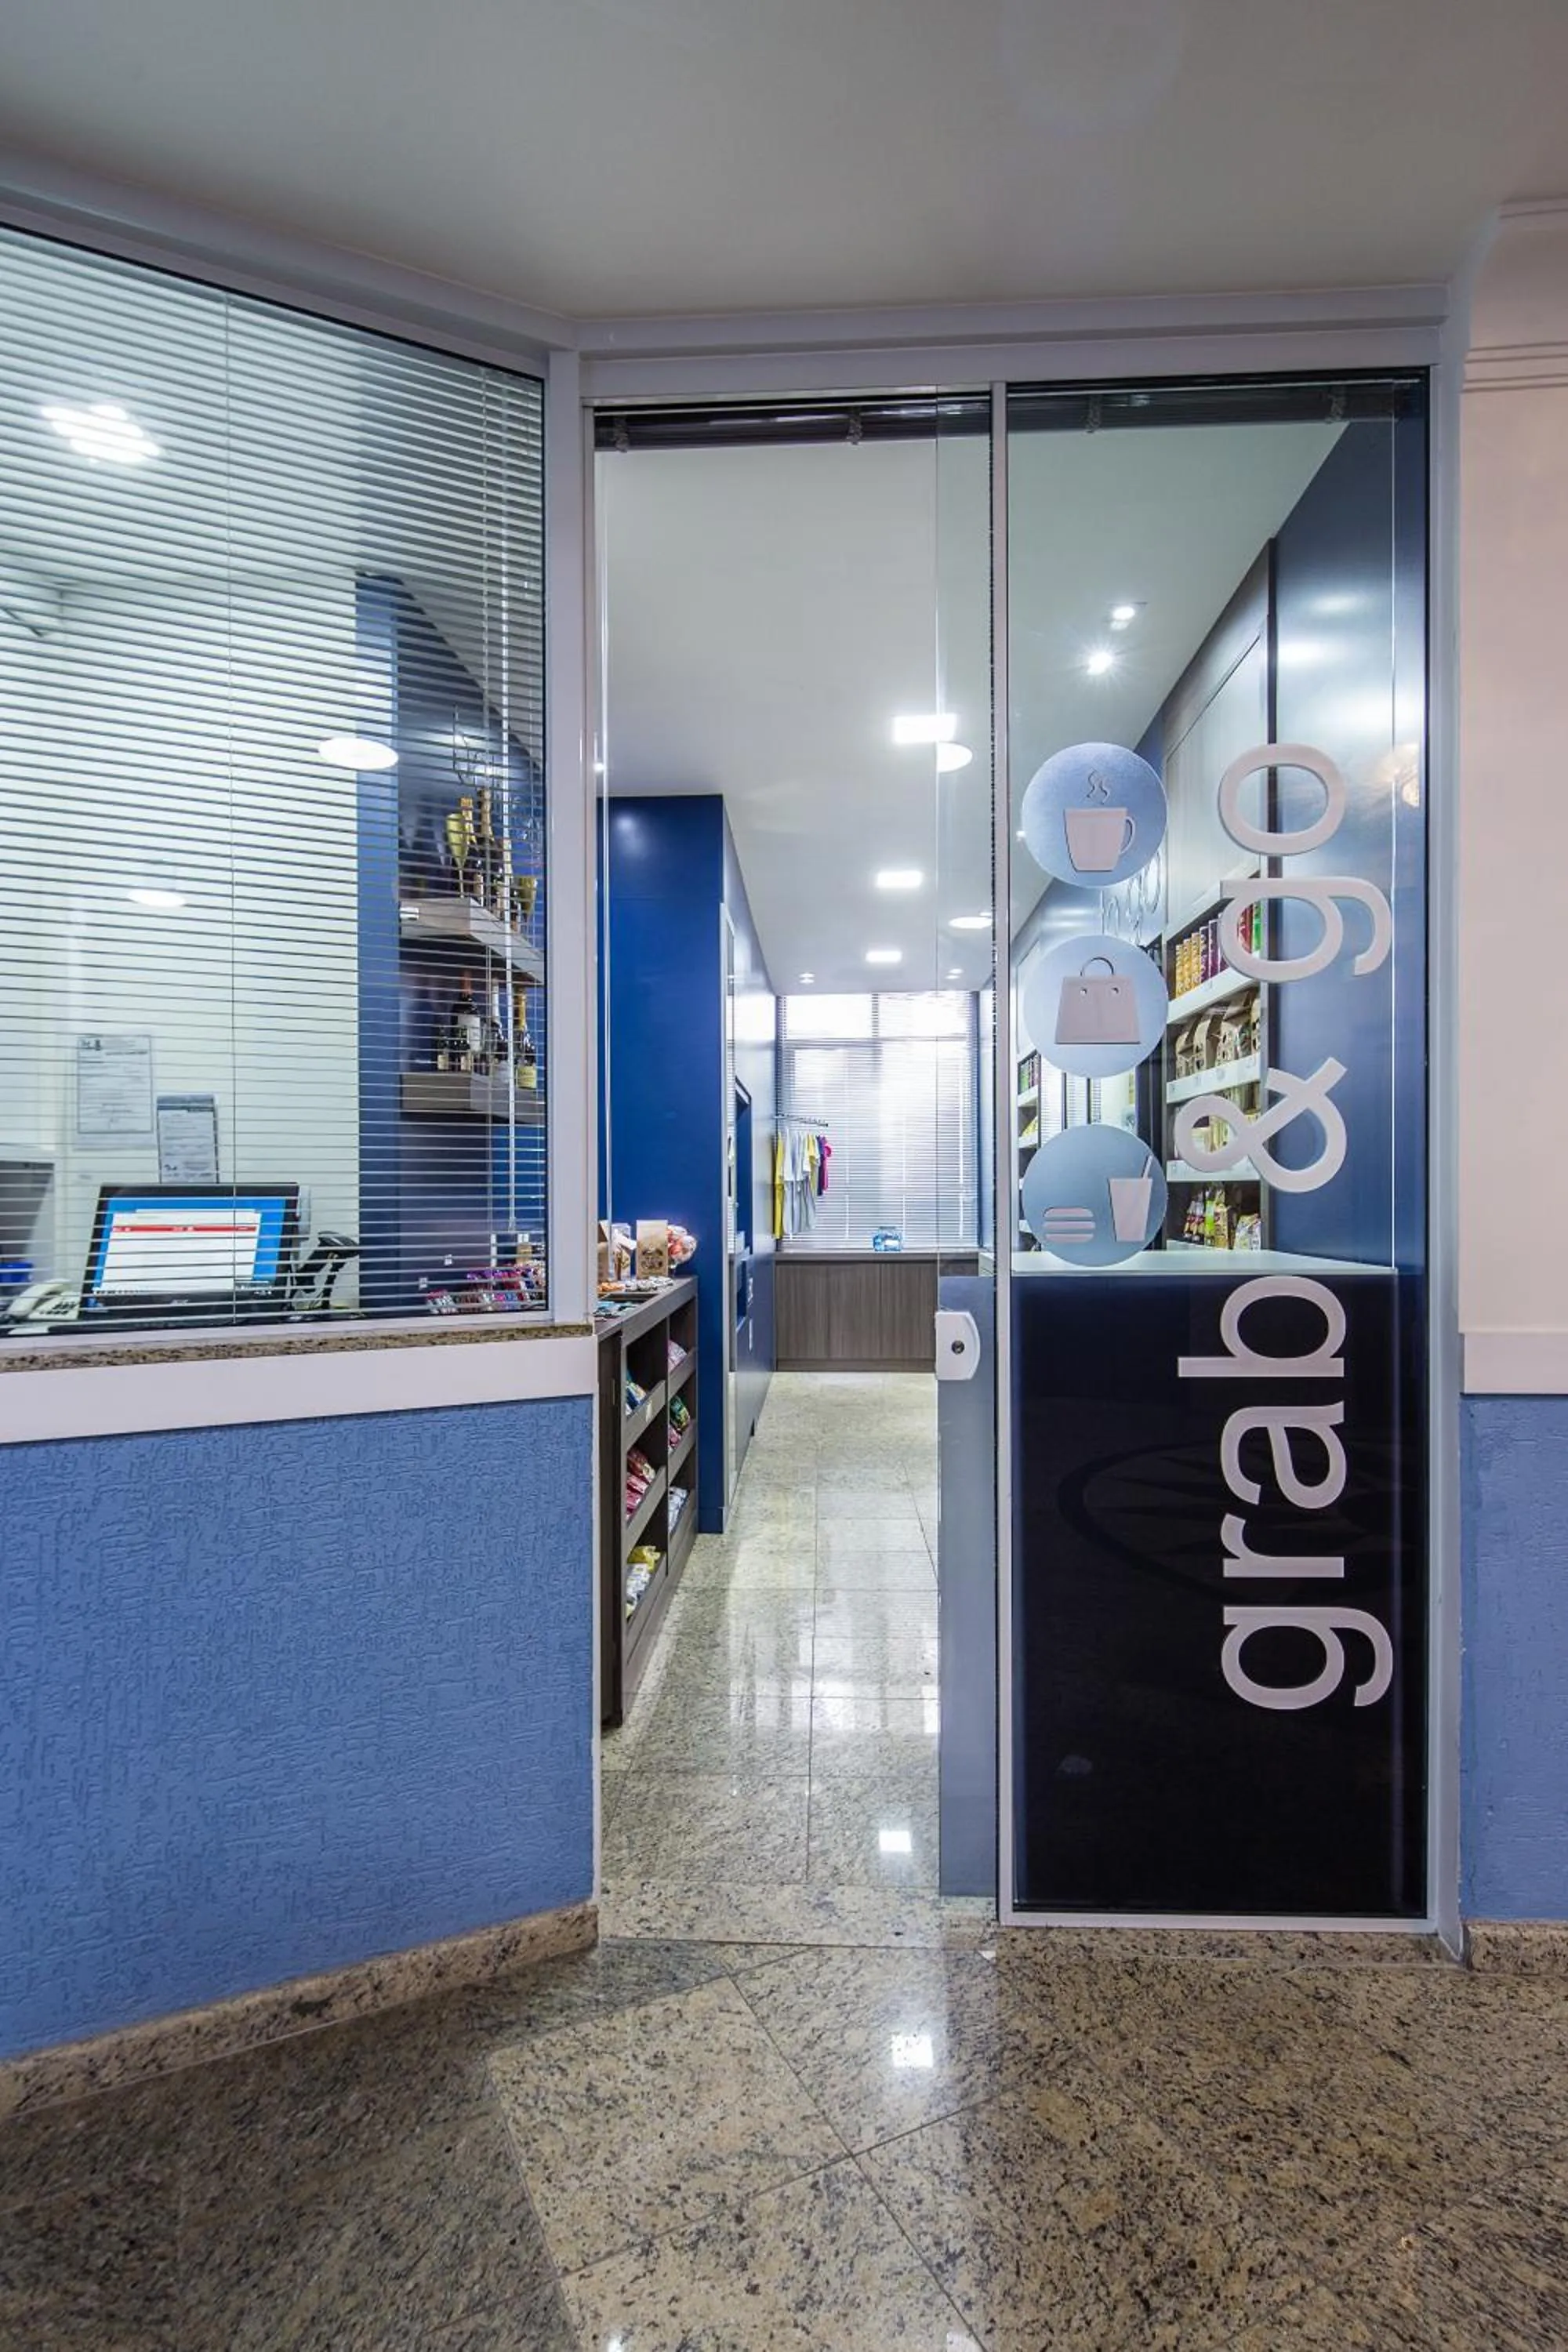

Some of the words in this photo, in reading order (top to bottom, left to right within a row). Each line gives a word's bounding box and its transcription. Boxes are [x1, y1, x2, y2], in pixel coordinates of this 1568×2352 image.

[1218, 742, 1392, 982] go
[1174, 1056, 1348, 1193] &
[1178, 1275, 1393, 1710] grab
